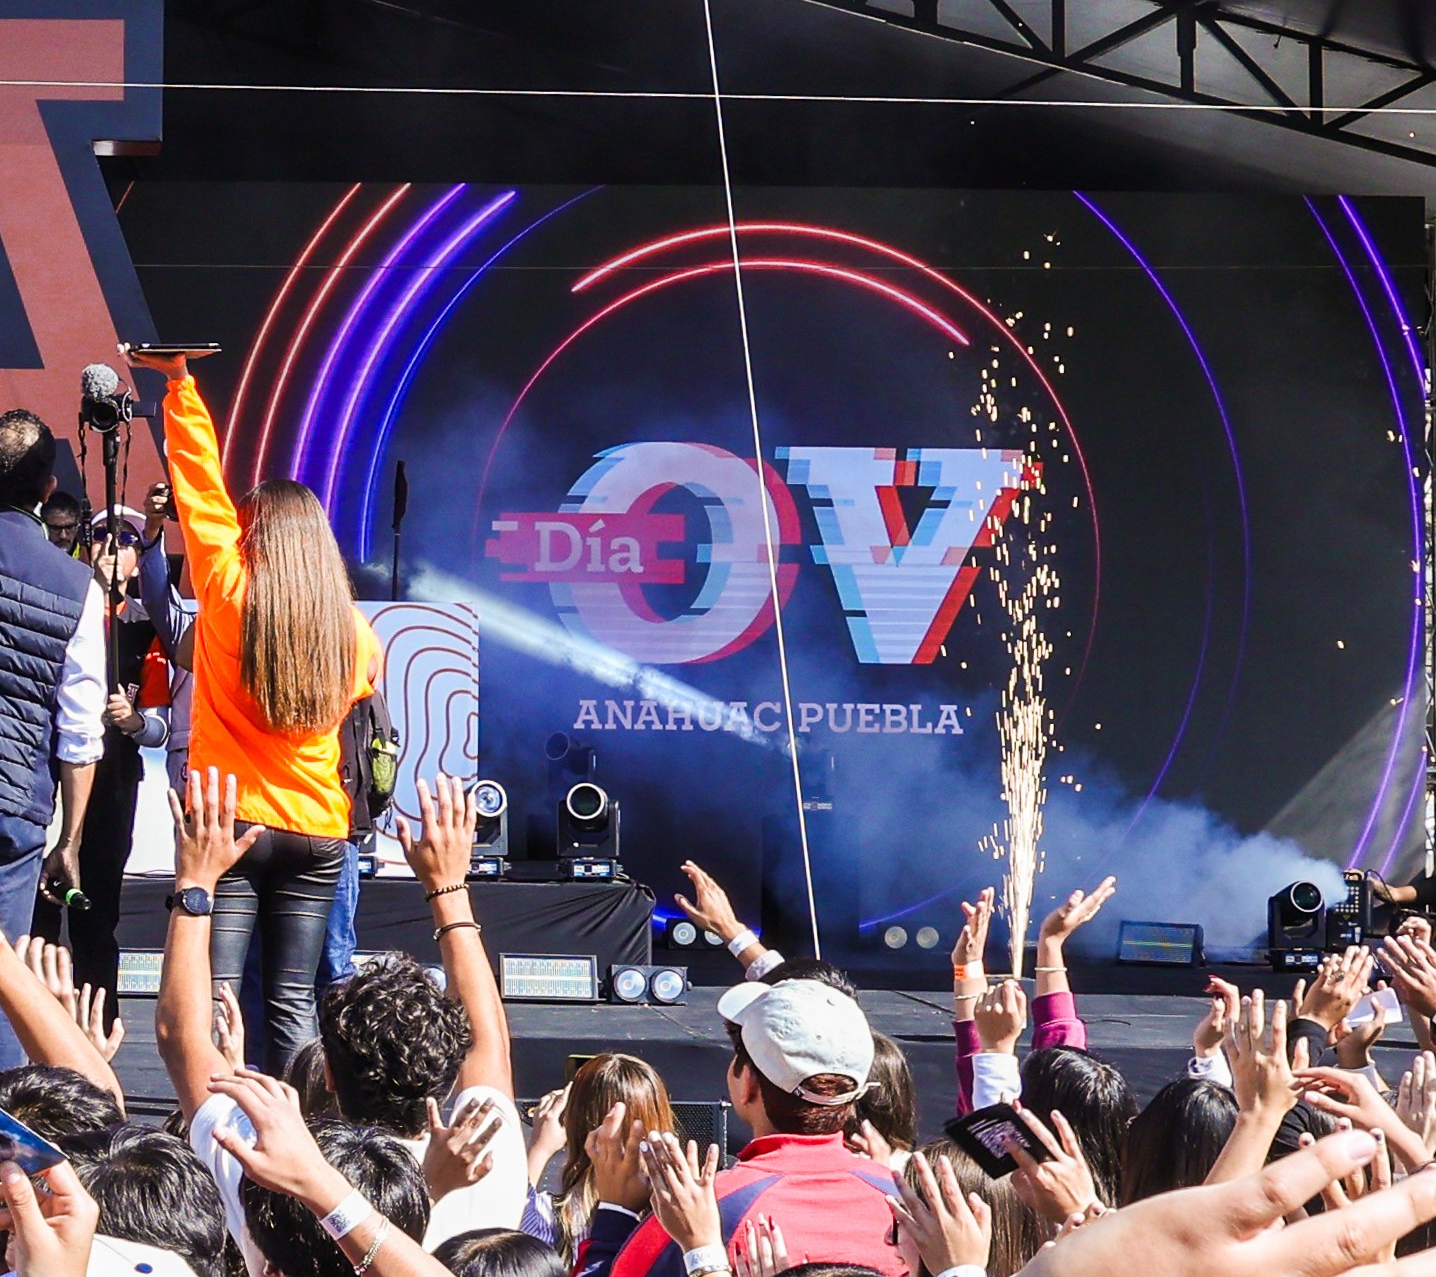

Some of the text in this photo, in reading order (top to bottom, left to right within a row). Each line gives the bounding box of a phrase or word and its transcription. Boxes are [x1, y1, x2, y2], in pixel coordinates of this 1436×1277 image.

[534, 441, 1044, 664] Día OV
[798, 702, 964, 735] PUEBLA
